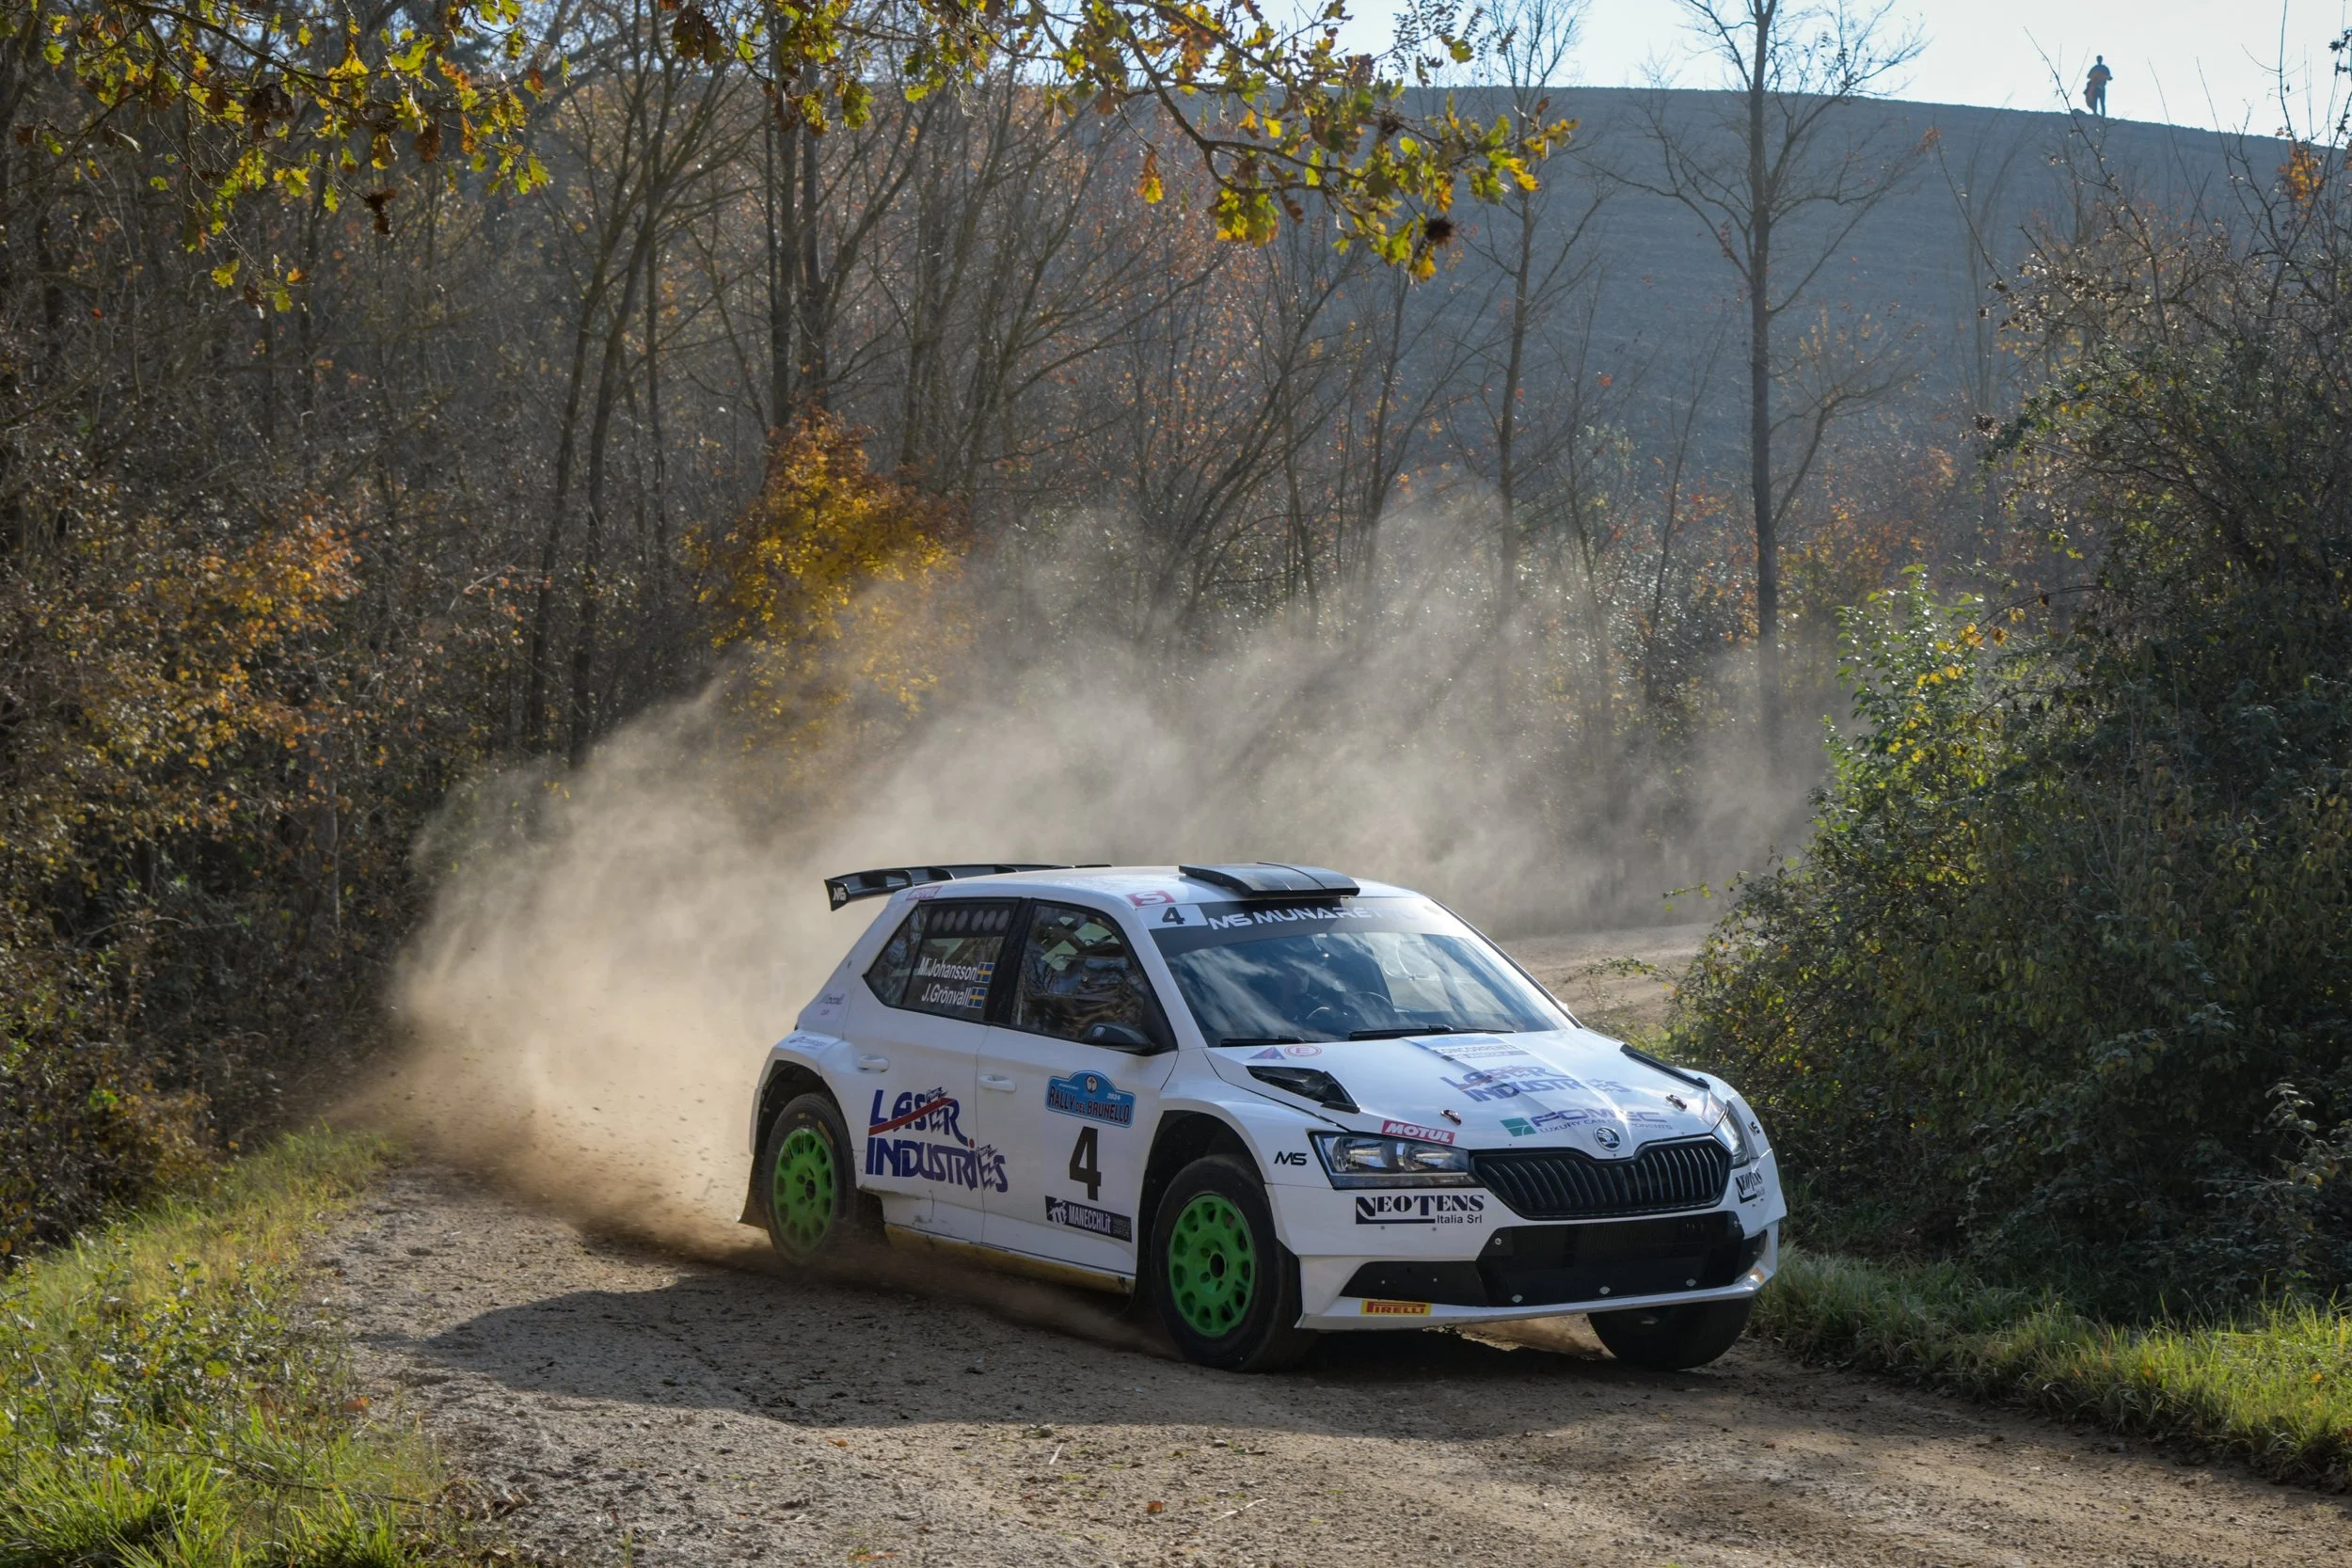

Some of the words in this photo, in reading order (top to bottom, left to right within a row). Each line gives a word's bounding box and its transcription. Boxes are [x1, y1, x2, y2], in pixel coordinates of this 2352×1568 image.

[1162, 907, 1185, 925] 4
[1208, 913, 1253, 930] MS
[1252, 906, 1420, 925] MUNARET
[918, 957, 977, 981] M.Johansson
[921, 983, 972, 1006] J.Grönvall
[1049, 1085, 1075, 1111] RALLY
[1076, 1101, 1085, 1114] DEL
[1087, 1100, 1130, 1123] BRUNELLO
[868, 1086, 968, 1147] LASER
[1539, 1120, 1581, 1133] LUXURY
[1385, 1123, 1451, 1143] MOTUL
[866, 1137, 1008, 1193] INDUSTRIES
[1069, 1126, 1102, 1202] 4
[1274, 1151, 1307, 1166] MS
[1356, 1196, 1485, 1218] NEOTENS
[1068, 1205, 1111, 1233] MANECCHI.it
[1437, 1214, 1463, 1224] Italia
[1467, 1214, 1483, 1224] Srl
[1366, 1301, 1427, 1314] PIRELLI
